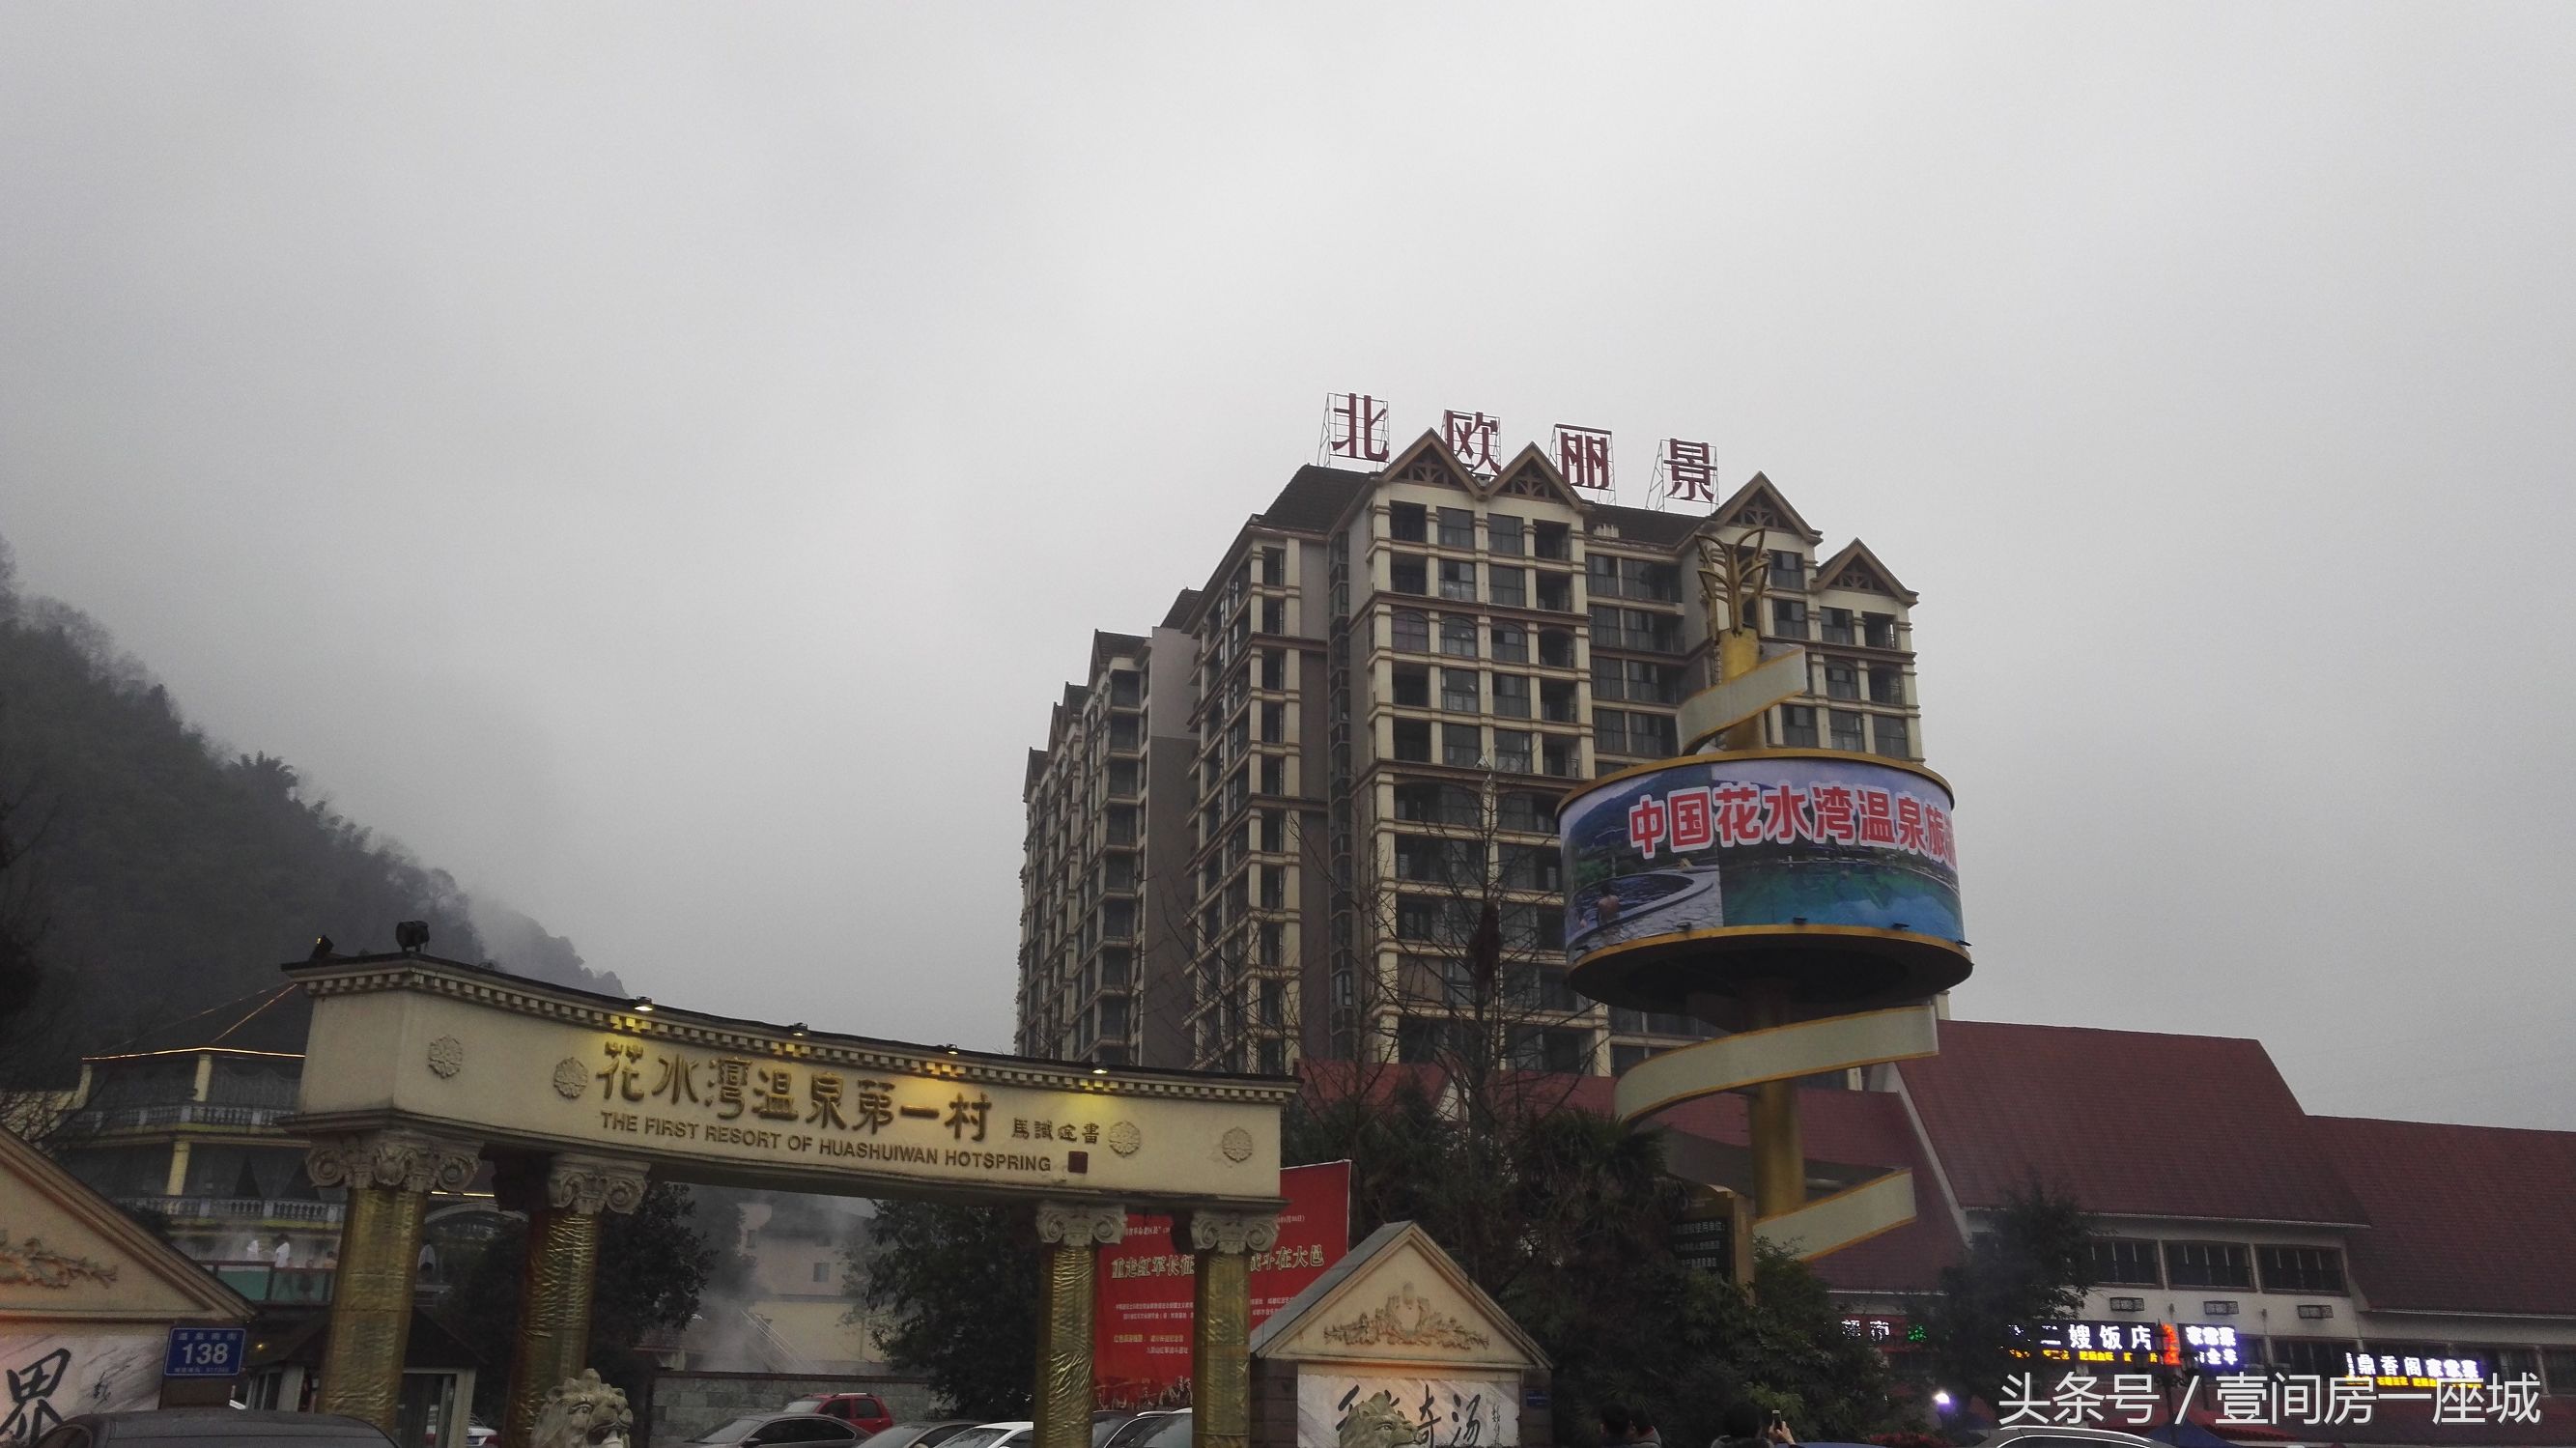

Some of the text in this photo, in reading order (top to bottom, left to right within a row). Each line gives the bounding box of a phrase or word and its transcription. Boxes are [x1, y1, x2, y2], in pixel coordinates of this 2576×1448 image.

[1331, 392, 1717, 502] 北欧丽景
[601, 1111, 1051, 1173] THE FIRST RESORT OF HUASHUIWAN HOTSPRING
[182, 1343, 229, 1365] 138
